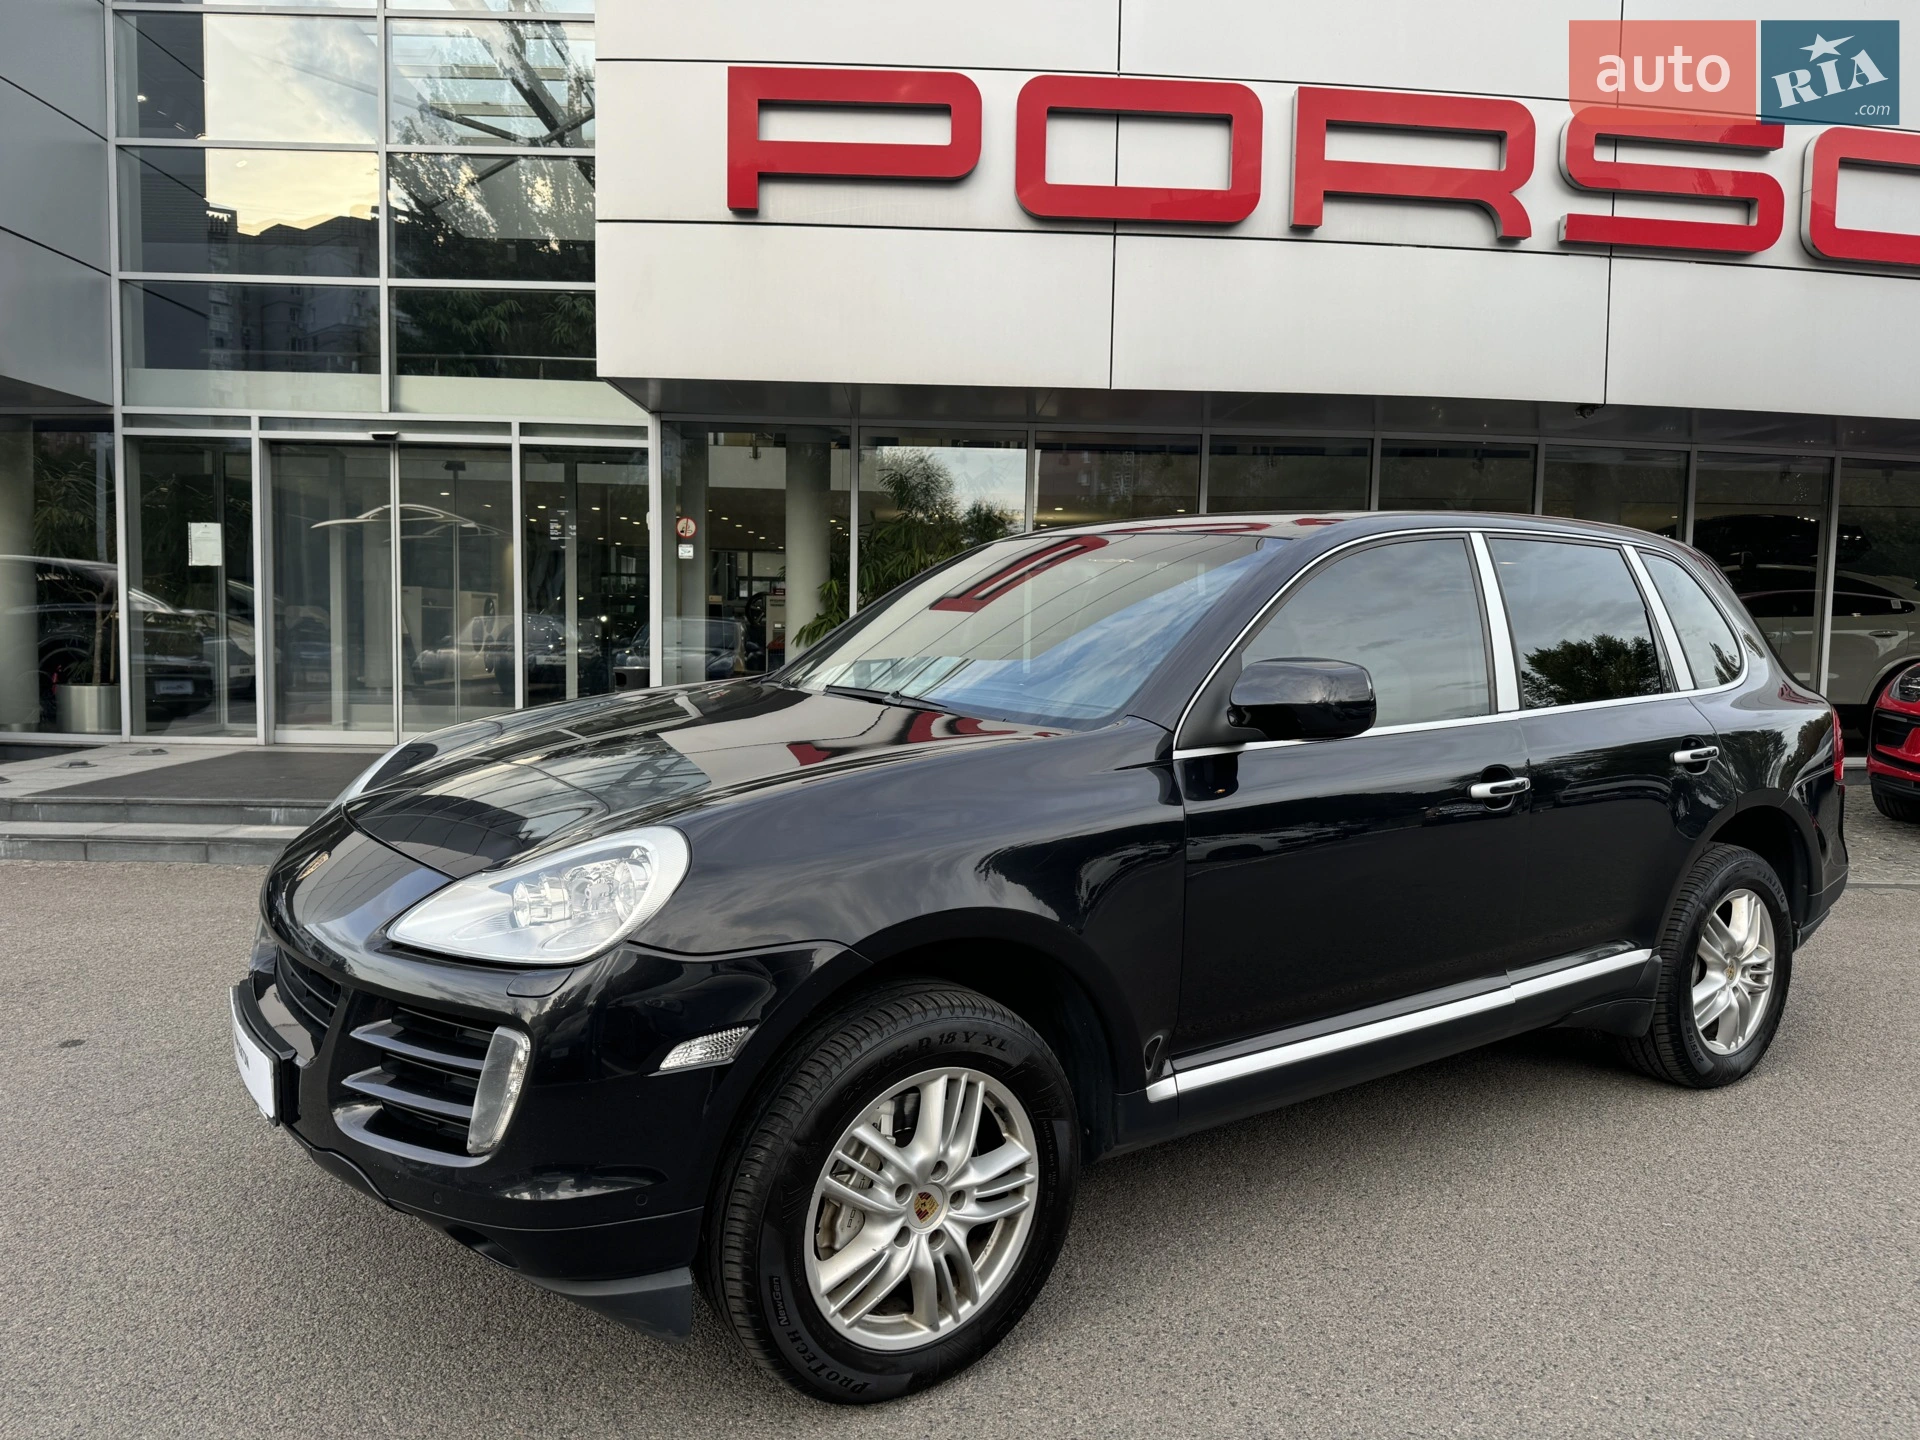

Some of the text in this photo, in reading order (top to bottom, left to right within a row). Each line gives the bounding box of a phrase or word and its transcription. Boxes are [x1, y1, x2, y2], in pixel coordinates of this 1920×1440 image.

[982, 1034, 1007, 1052] XL
[772, 1277, 872, 1394] PROTECH NewGen
